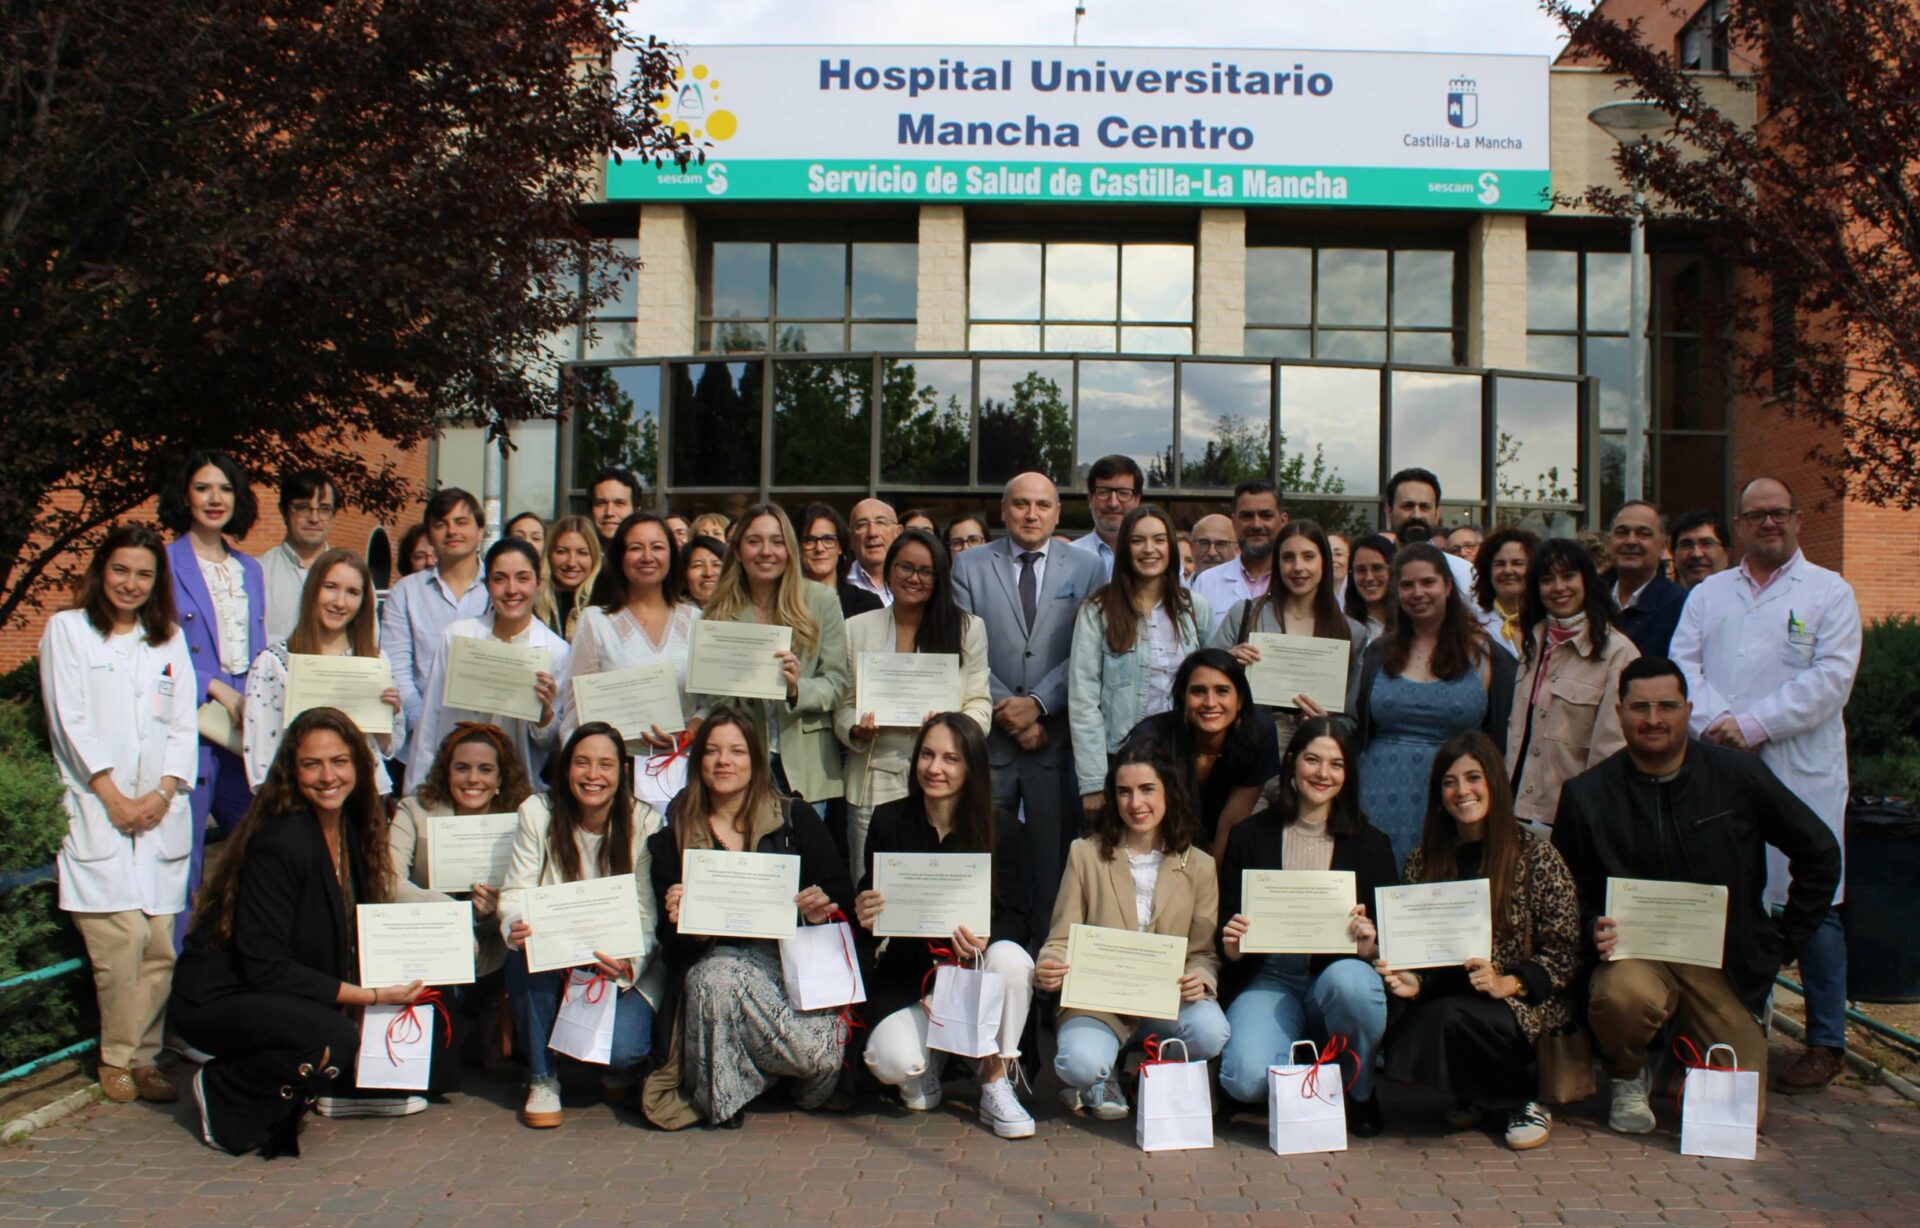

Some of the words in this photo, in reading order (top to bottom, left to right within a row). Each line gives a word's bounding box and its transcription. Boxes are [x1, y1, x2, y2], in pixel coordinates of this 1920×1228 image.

[820, 58, 1012, 97] Hospital
[1031, 60, 1334, 97] Universitario
[897, 113, 1080, 148] Mancha
[1096, 115, 1254, 151] Centro
[1403, 134, 1471, 149] Castilla-La
[1475, 135, 1523, 150] Mancha
[657, 174, 703, 184] sescam
[807, 162, 918, 193] Servicio
[925, 165, 958, 194] de
[965, 165, 1042, 195] Salud
[1049, 167, 1082, 197] de
[1089, 167, 1234, 198] Castilla-La
[1242, 169, 1348, 199] Mancha
[1428, 182, 1474, 193] sescam
